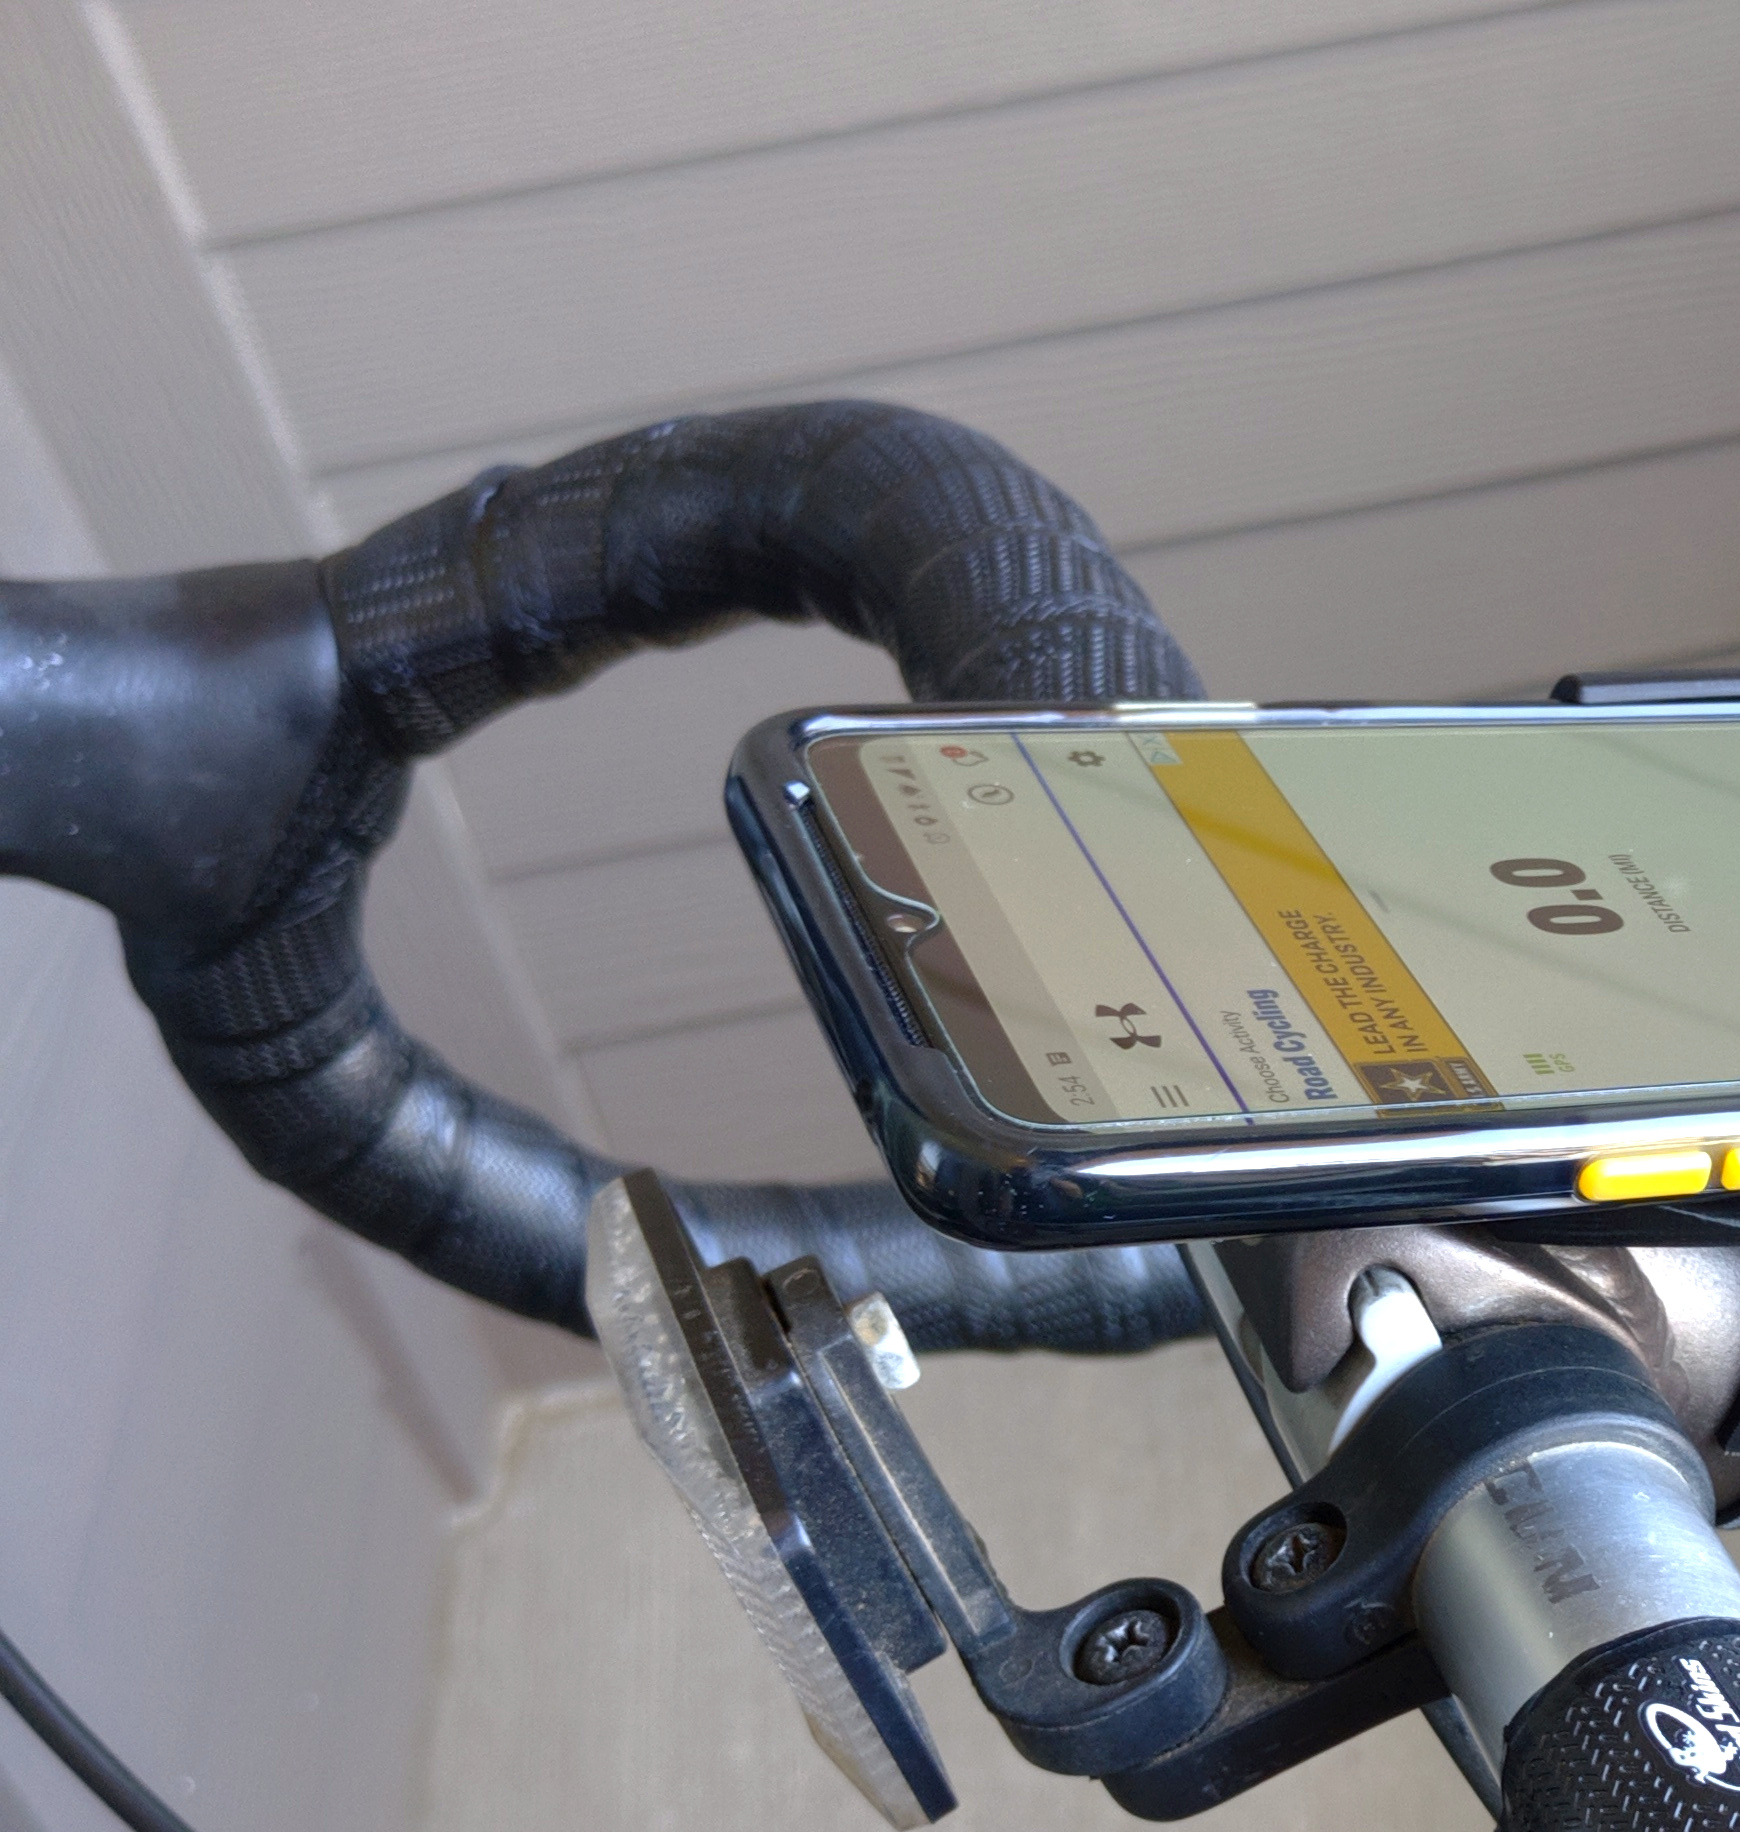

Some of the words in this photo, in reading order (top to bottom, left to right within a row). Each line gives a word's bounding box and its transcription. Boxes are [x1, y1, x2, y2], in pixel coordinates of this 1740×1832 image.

[1607, 853, 1645, 875] (MI)
[1489, 857, 1625, 936] 0.0
[1626, 876, 1691, 934] DISTANCE
[1277, 908, 1340, 975] CHARGE
[1313, 911, 1387, 994] INDUSTRY.
[1323, 976, 1363, 1010] THE
[1370, 996, 1415, 1031] ANY
[1220, 1010, 1257, 1053] Activity
[1246, 988, 1308, 1053] Cycling
[1349, 1012, 1397, 1055] LEAD
[1397, 1036, 1429, 1052] IN
[1549, 1053, 1575, 1073] GPS
[1058, 1075, 1096, 1107] 2:54
[1250, 1055, 1290, 1103] Choose
[1282, 1054, 1339, 1101] Road
